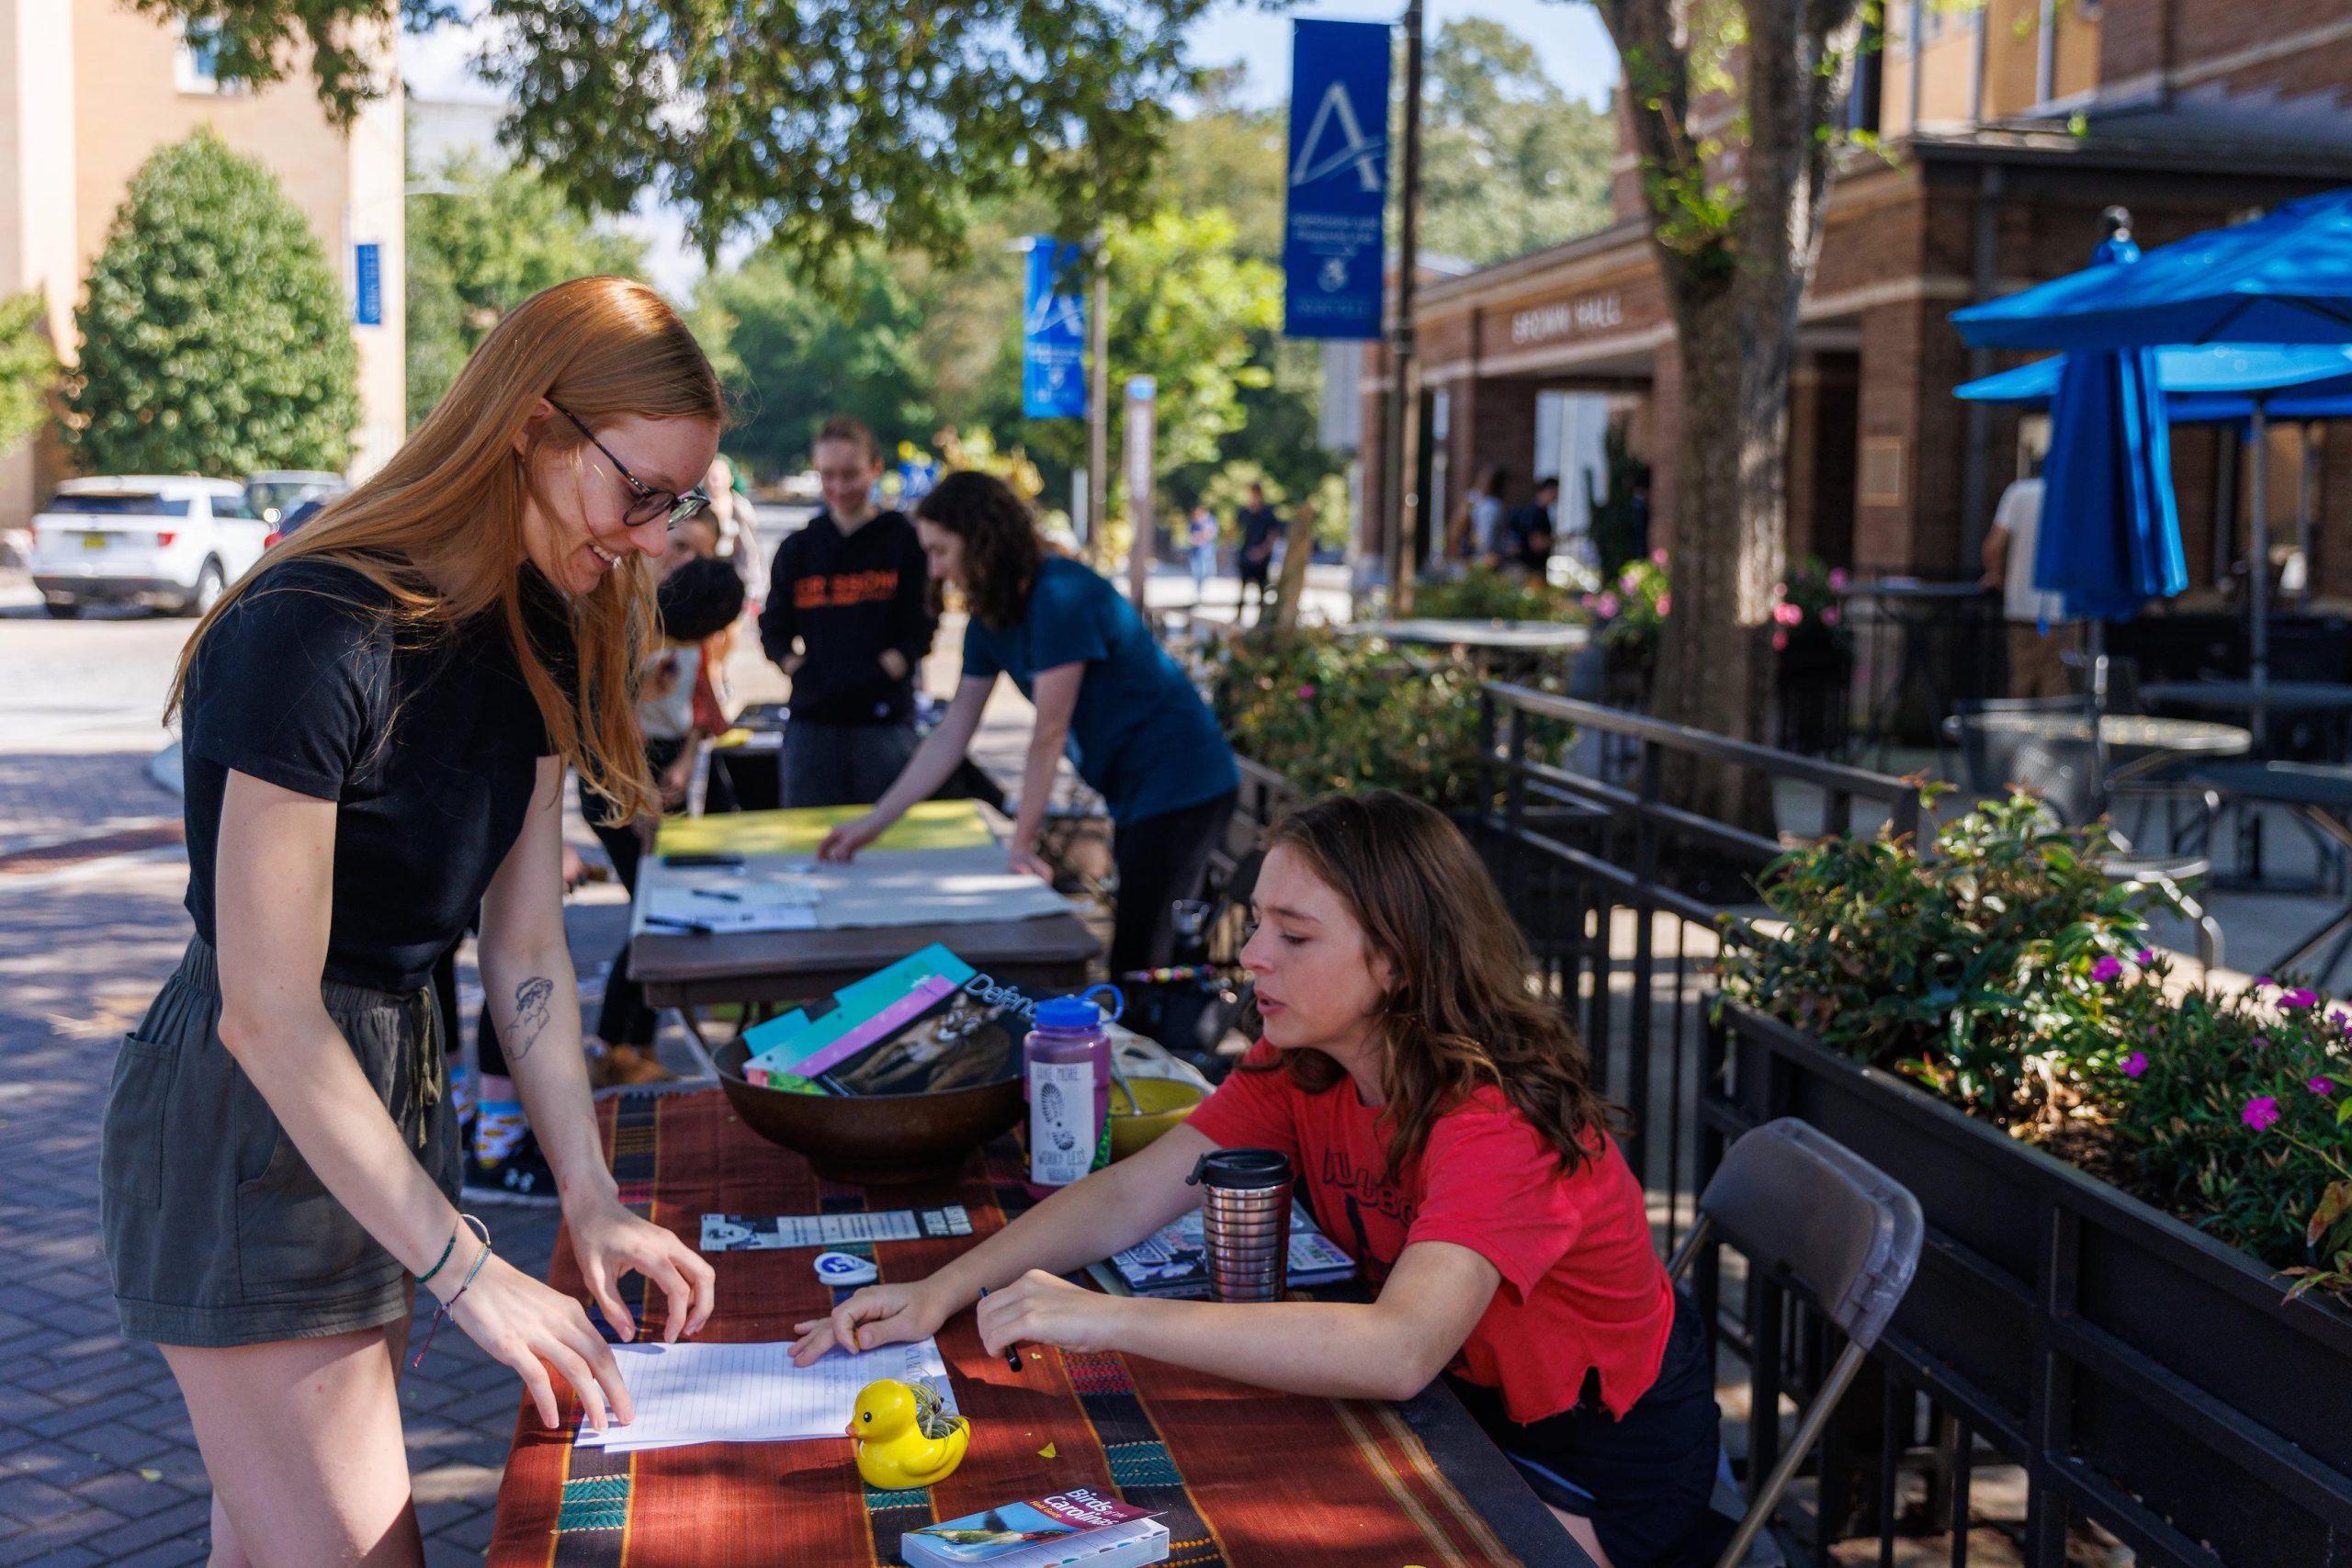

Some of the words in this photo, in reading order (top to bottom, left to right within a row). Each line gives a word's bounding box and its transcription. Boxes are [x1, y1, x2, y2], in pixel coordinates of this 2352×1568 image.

[965, 974, 1036, 1017] Defen
[1044, 1495, 1119, 1525] Carolinas
[1046, 1506, 1063, 1518] Guide
[1066, 1488, 1113, 1512] Birds
